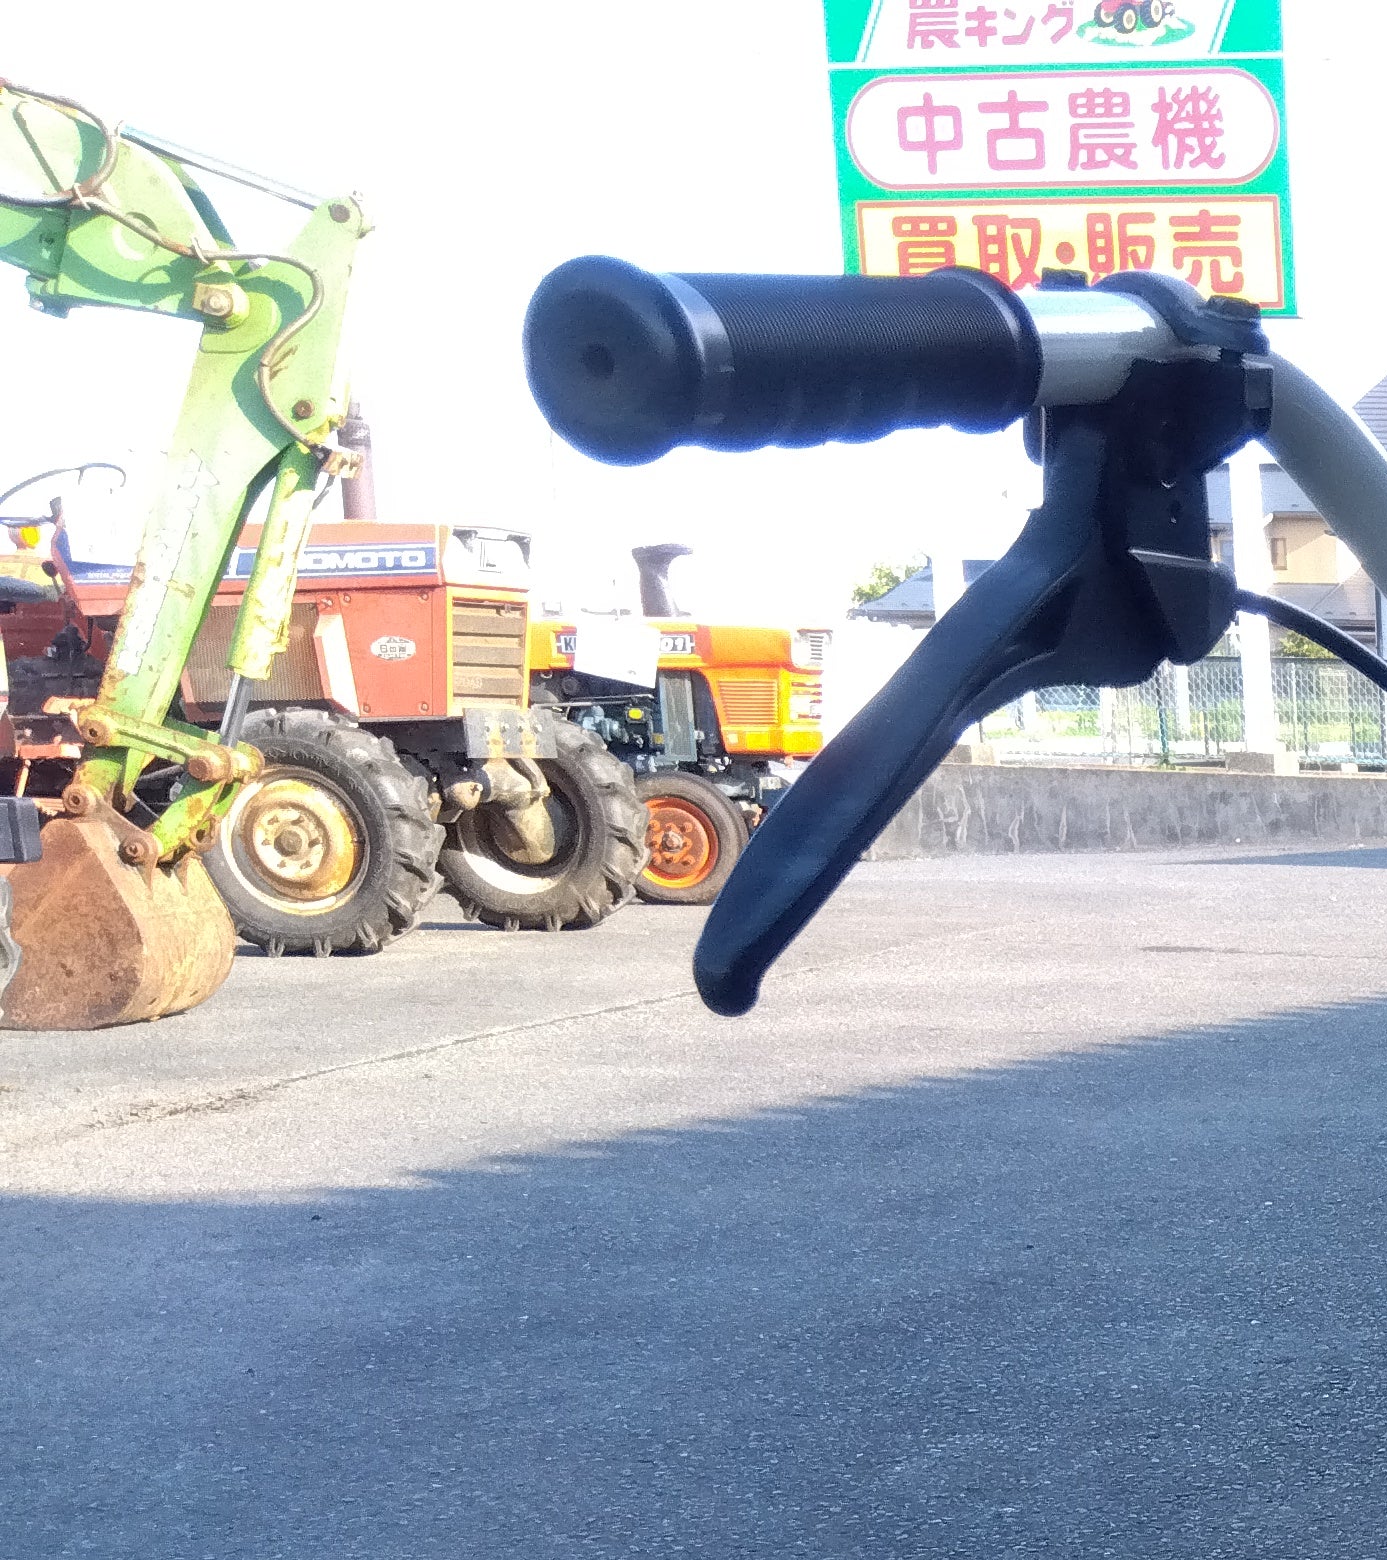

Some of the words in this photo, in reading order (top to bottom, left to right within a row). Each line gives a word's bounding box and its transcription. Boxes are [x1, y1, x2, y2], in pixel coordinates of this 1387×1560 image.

[897, 85, 1226, 175] 中古農機
[891, 209, 1244, 294] 買取・販売
